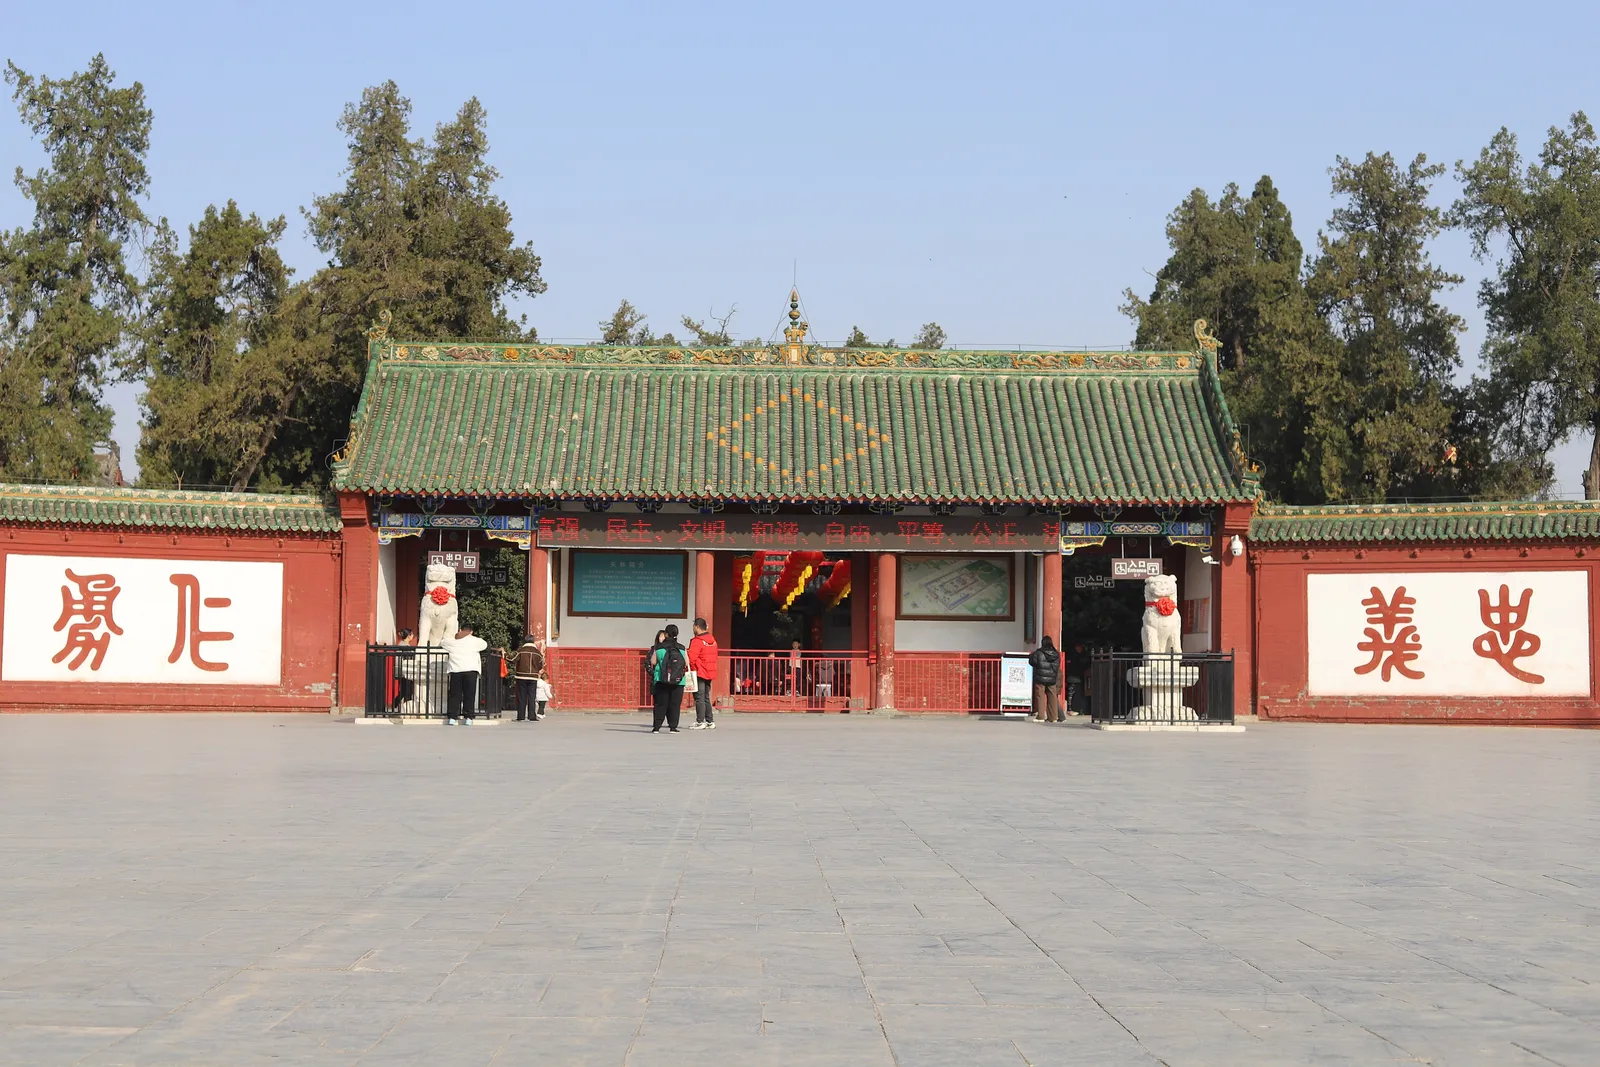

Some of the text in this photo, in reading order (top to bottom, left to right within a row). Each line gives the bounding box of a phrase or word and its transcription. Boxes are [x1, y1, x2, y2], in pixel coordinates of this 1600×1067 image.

[446, 553, 462, 561] 出口
[1129, 559, 1146, 568] 入口
[1087, 574, 1103, 582] 入口
